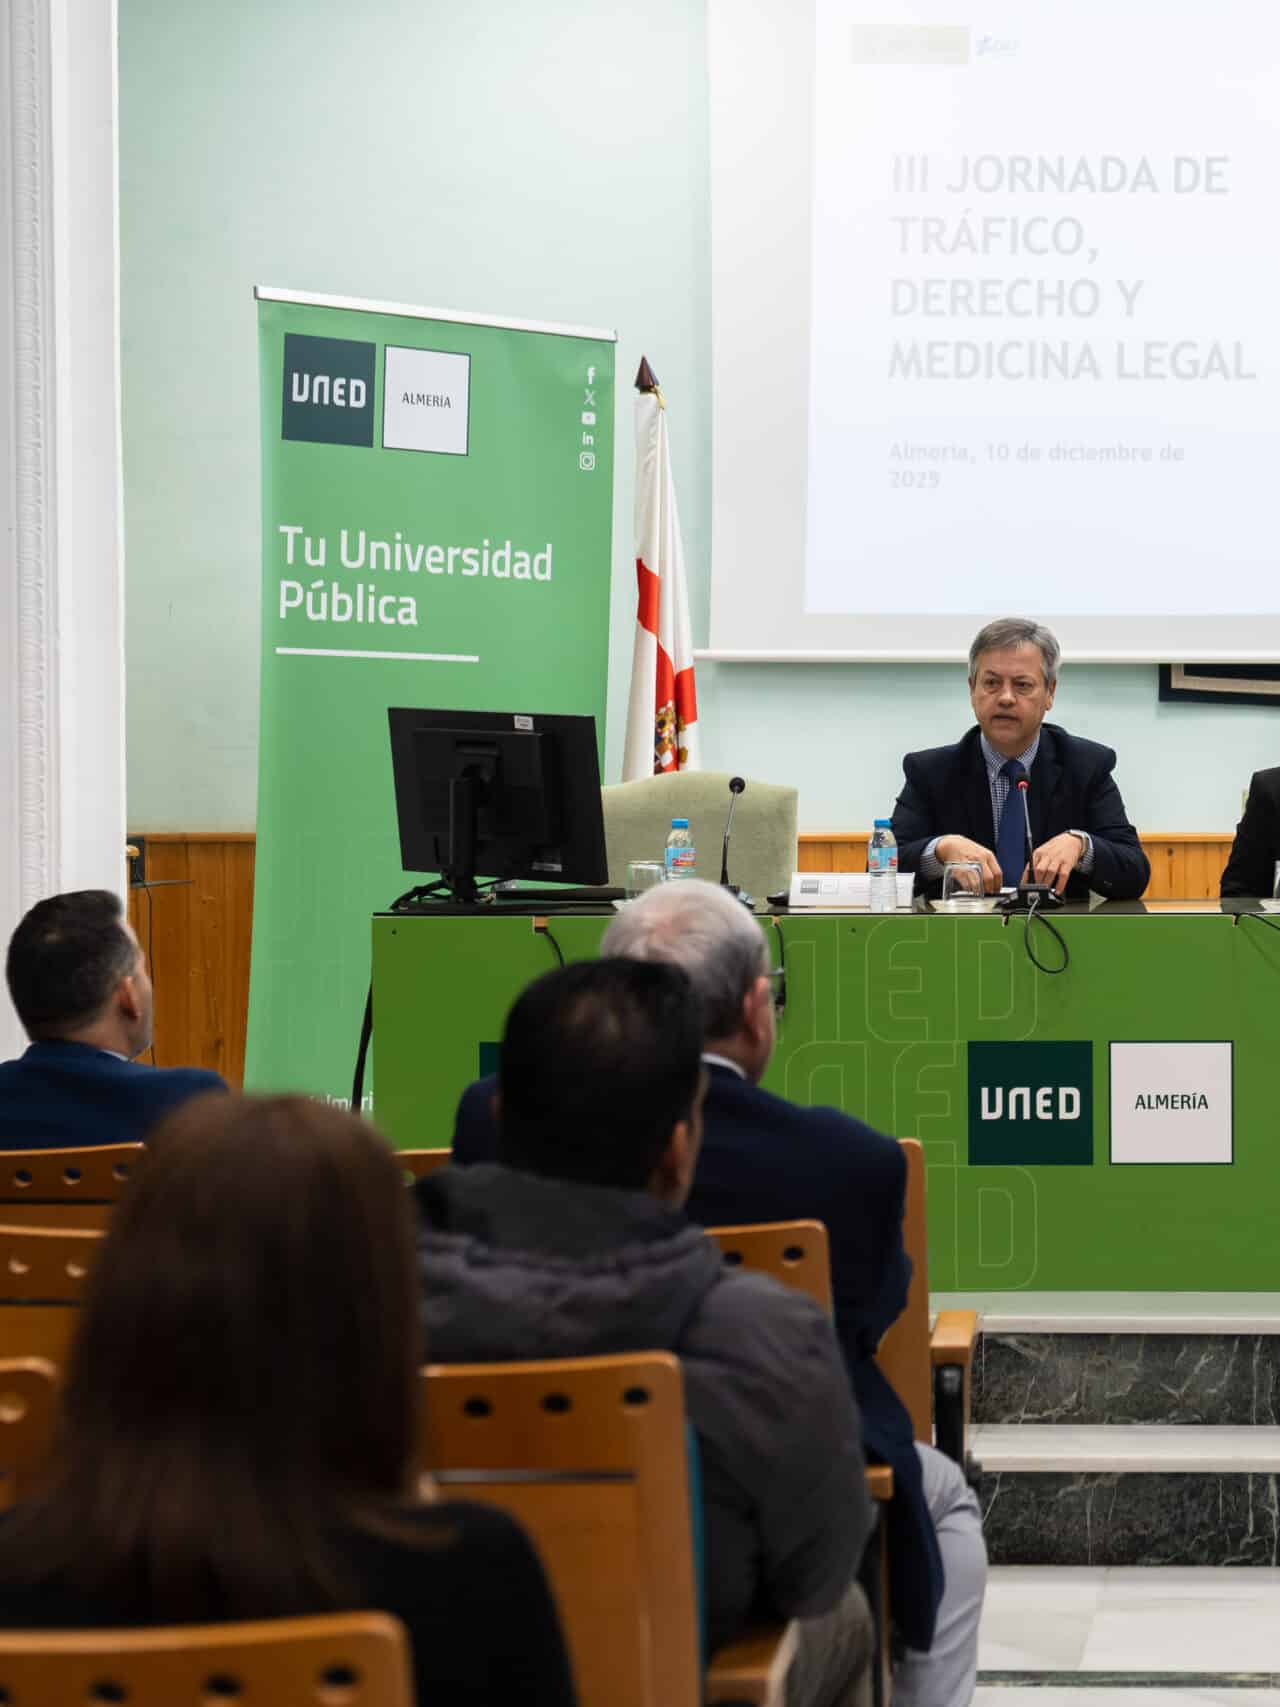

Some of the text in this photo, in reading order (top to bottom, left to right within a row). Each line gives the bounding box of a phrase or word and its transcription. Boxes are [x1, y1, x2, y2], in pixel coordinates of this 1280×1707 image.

[892, 154, 1230, 194] III JORNADA DE
[889, 207, 1099, 264] TRÁFICO,
[890, 277, 1145, 318] DERECHO Y
[888, 339, 1257, 380] MEDICINA LEGAL
[291, 372, 367, 409] UNED
[401, 390, 452, 409] ALMERÍA
[986, 442, 1011, 462] 10
[1016, 441, 1042, 462] de
[1048, 441, 1153, 463] diciembre
[1159, 441, 1185, 462] de
[278, 524, 553, 581] Tu Universidad
[279, 578, 418, 625] Pública
[980, 1086, 1081, 1120] UNED
[1135, 1091, 1209, 1111] ALMERÍA
